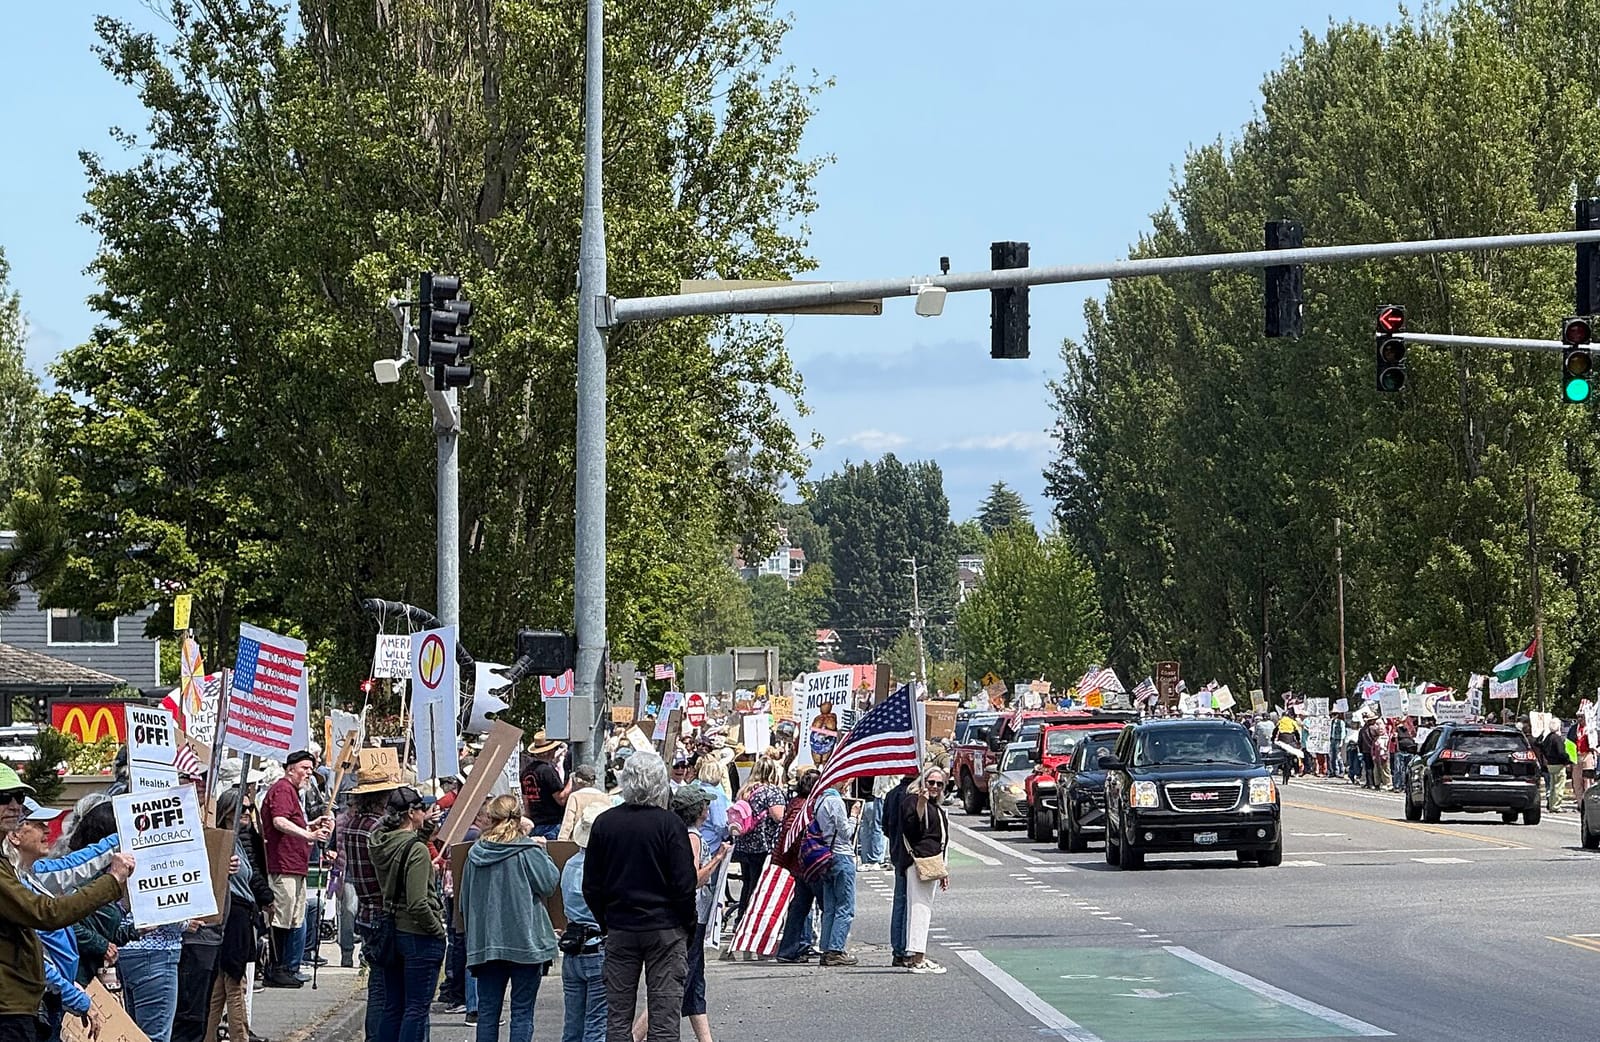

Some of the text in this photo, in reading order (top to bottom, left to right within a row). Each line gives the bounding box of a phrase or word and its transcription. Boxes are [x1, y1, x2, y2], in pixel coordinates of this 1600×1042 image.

[873, 304, 879, 314] 3
[808, 673, 849, 692] SAVE THE
[806, 690, 847, 709] MOTHER
[132, 711, 167, 727] HANDS
[190, 714, 205, 723] THE
[134, 725, 170, 747] OFF!
[370, 752, 388, 766] NO
[1190, 792, 1219, 800] GMC
[132, 796, 182, 814] HANDS
[134, 808, 184, 834] OFF!
[131, 828, 194, 847] DEMOCRACY
[150, 857, 185, 872] and the
[138, 870, 202, 891] RULE OF
[156, 891, 190, 907] LAW
